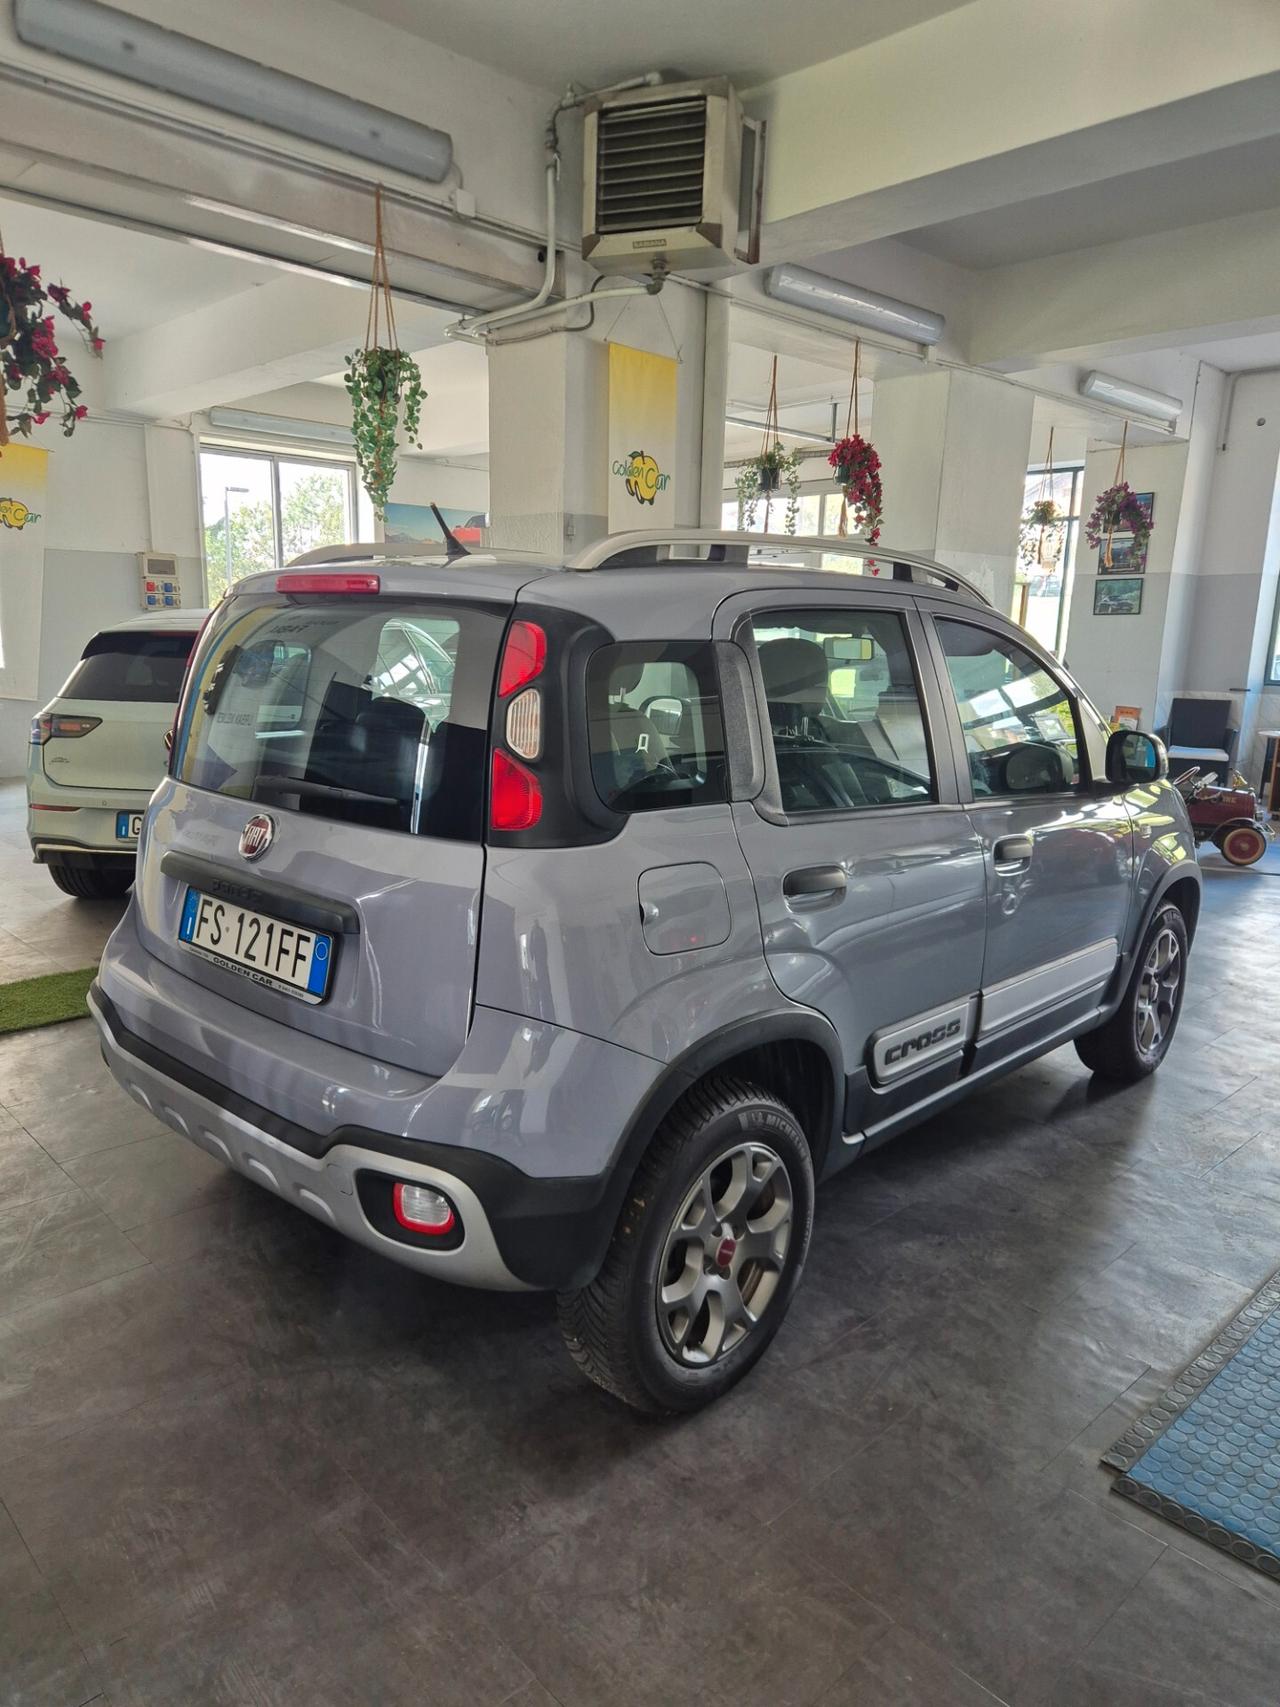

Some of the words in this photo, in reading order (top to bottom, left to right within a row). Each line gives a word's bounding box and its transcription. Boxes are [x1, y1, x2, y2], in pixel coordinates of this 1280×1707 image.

[645, 467, 671, 491] Car
[13, 508, 42, 523] Car
[245, 824, 266, 848] FIAT
[212, 956, 250, 977] GOLDEN
[251, 973, 274, 987] CAR
